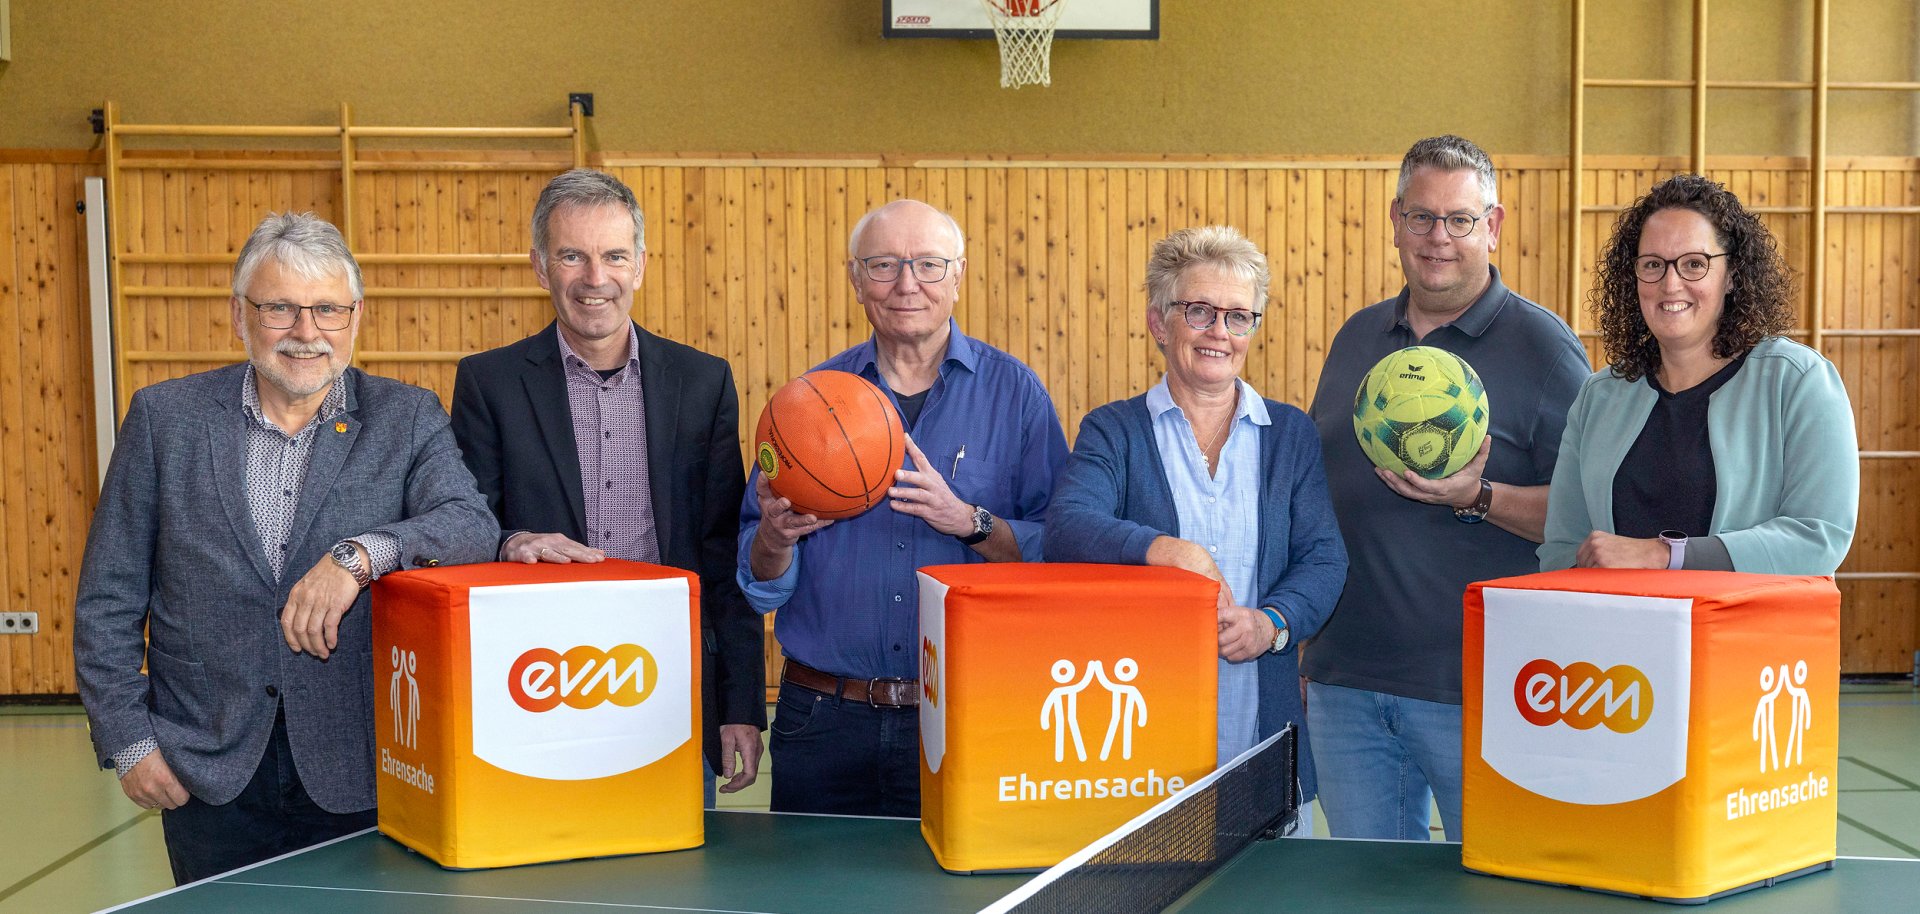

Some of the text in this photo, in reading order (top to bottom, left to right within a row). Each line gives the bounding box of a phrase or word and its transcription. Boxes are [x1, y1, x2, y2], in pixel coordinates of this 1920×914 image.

[1399, 373, 1425, 381] erima
[521, 656, 644, 700] evm
[1525, 672, 1640, 720] evm
[381, 748, 435, 795] Ehrensache
[999, 769, 1185, 802] Ehrensache
[1726, 771, 1829, 821] Ehrensache
